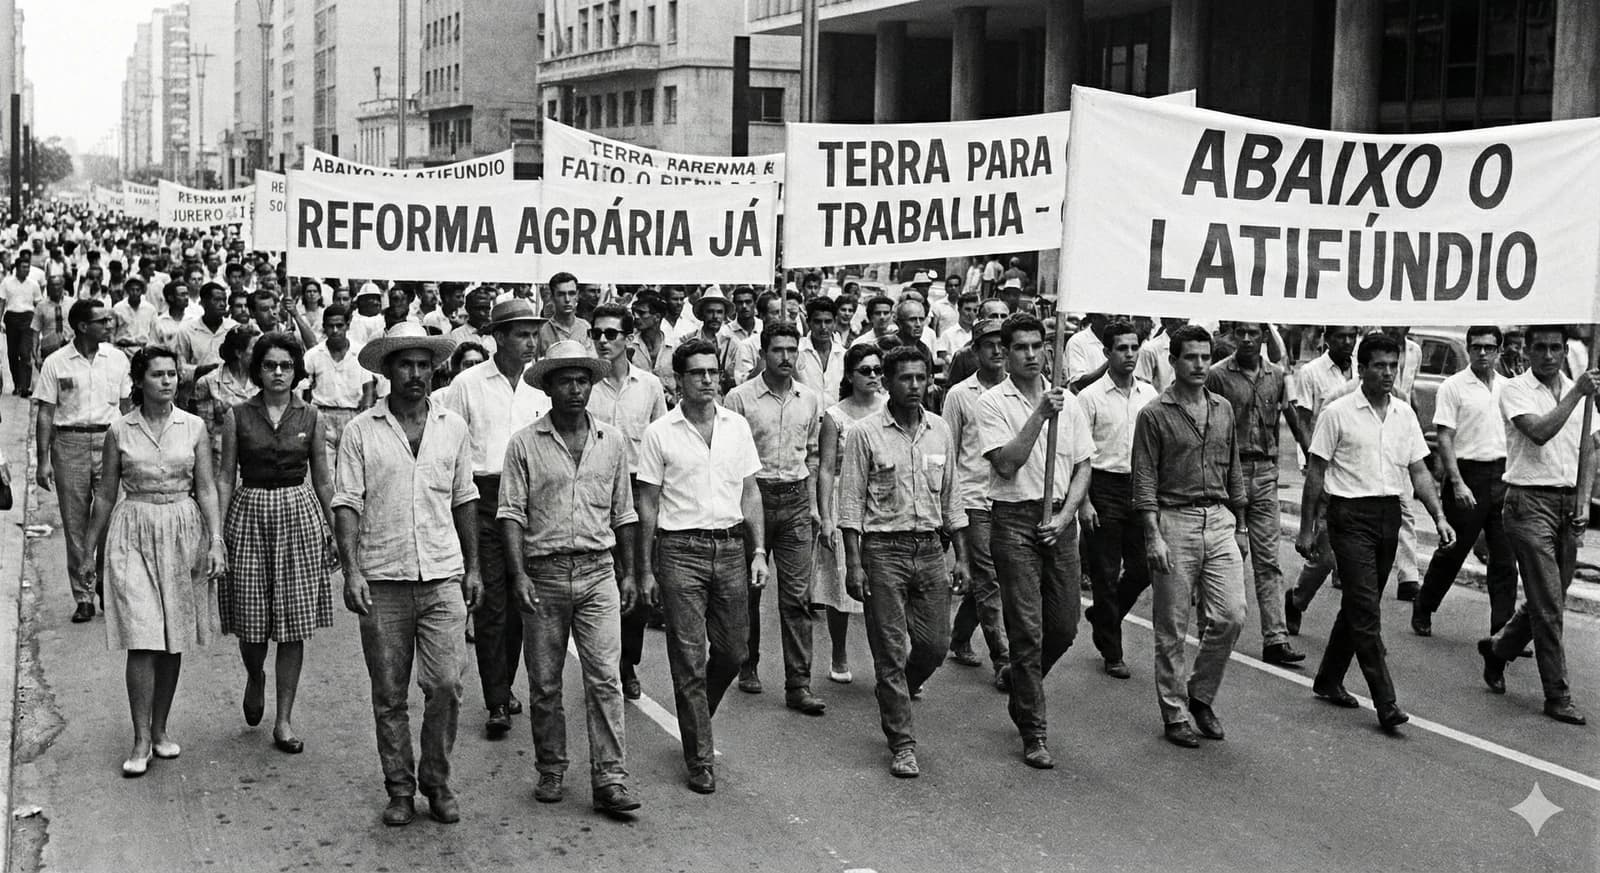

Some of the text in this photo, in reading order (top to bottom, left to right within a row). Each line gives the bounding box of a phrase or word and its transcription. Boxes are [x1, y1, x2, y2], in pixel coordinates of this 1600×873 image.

[272, 181, 286, 193] RE
[403, 159, 505, 179] TIFUNDIO
[818, 136, 1052, 187] TERRA PARA
[1182, 128, 1513, 210] ABAIXO O
[298, 195, 762, 257] REFORMA AGRÁRIA JÁ
[817, 191, 1024, 247] TRABALHA
[1147, 212, 1538, 301] LATIFÚNDIO
